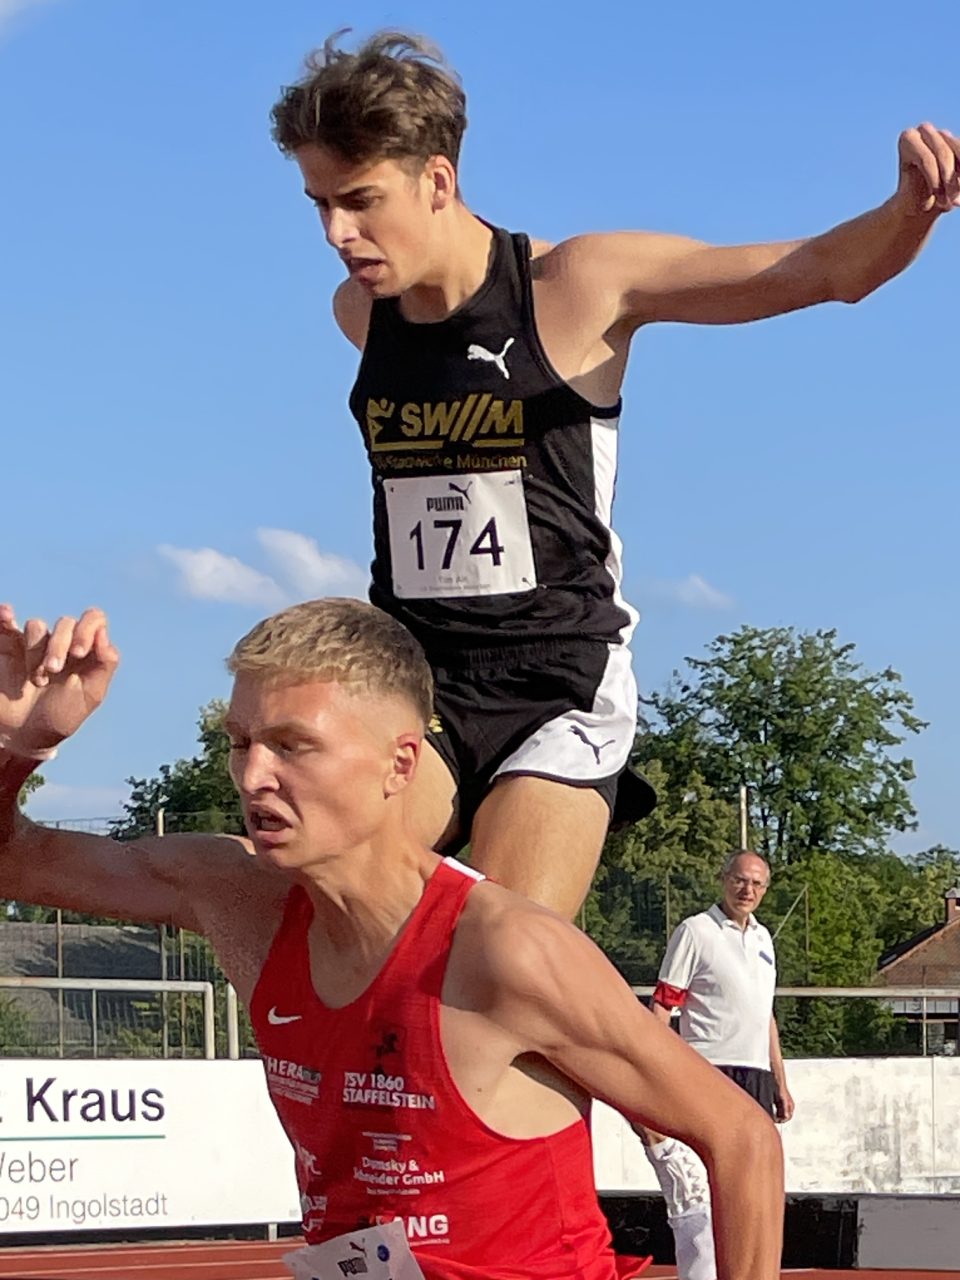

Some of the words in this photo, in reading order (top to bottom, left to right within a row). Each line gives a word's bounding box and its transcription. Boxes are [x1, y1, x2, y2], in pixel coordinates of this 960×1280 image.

[409, 516, 505, 570] 174
[370, 1073, 404, 1091] 1860
[26, 1077, 166, 1122] Kraus
[342, 1088, 435, 1110] STAFFELSTEIN
[408, 1159, 419, 1171] &
[402, 1170, 445, 1186] GmbH
[49, 1192, 168, 1225] Ingolstadt
